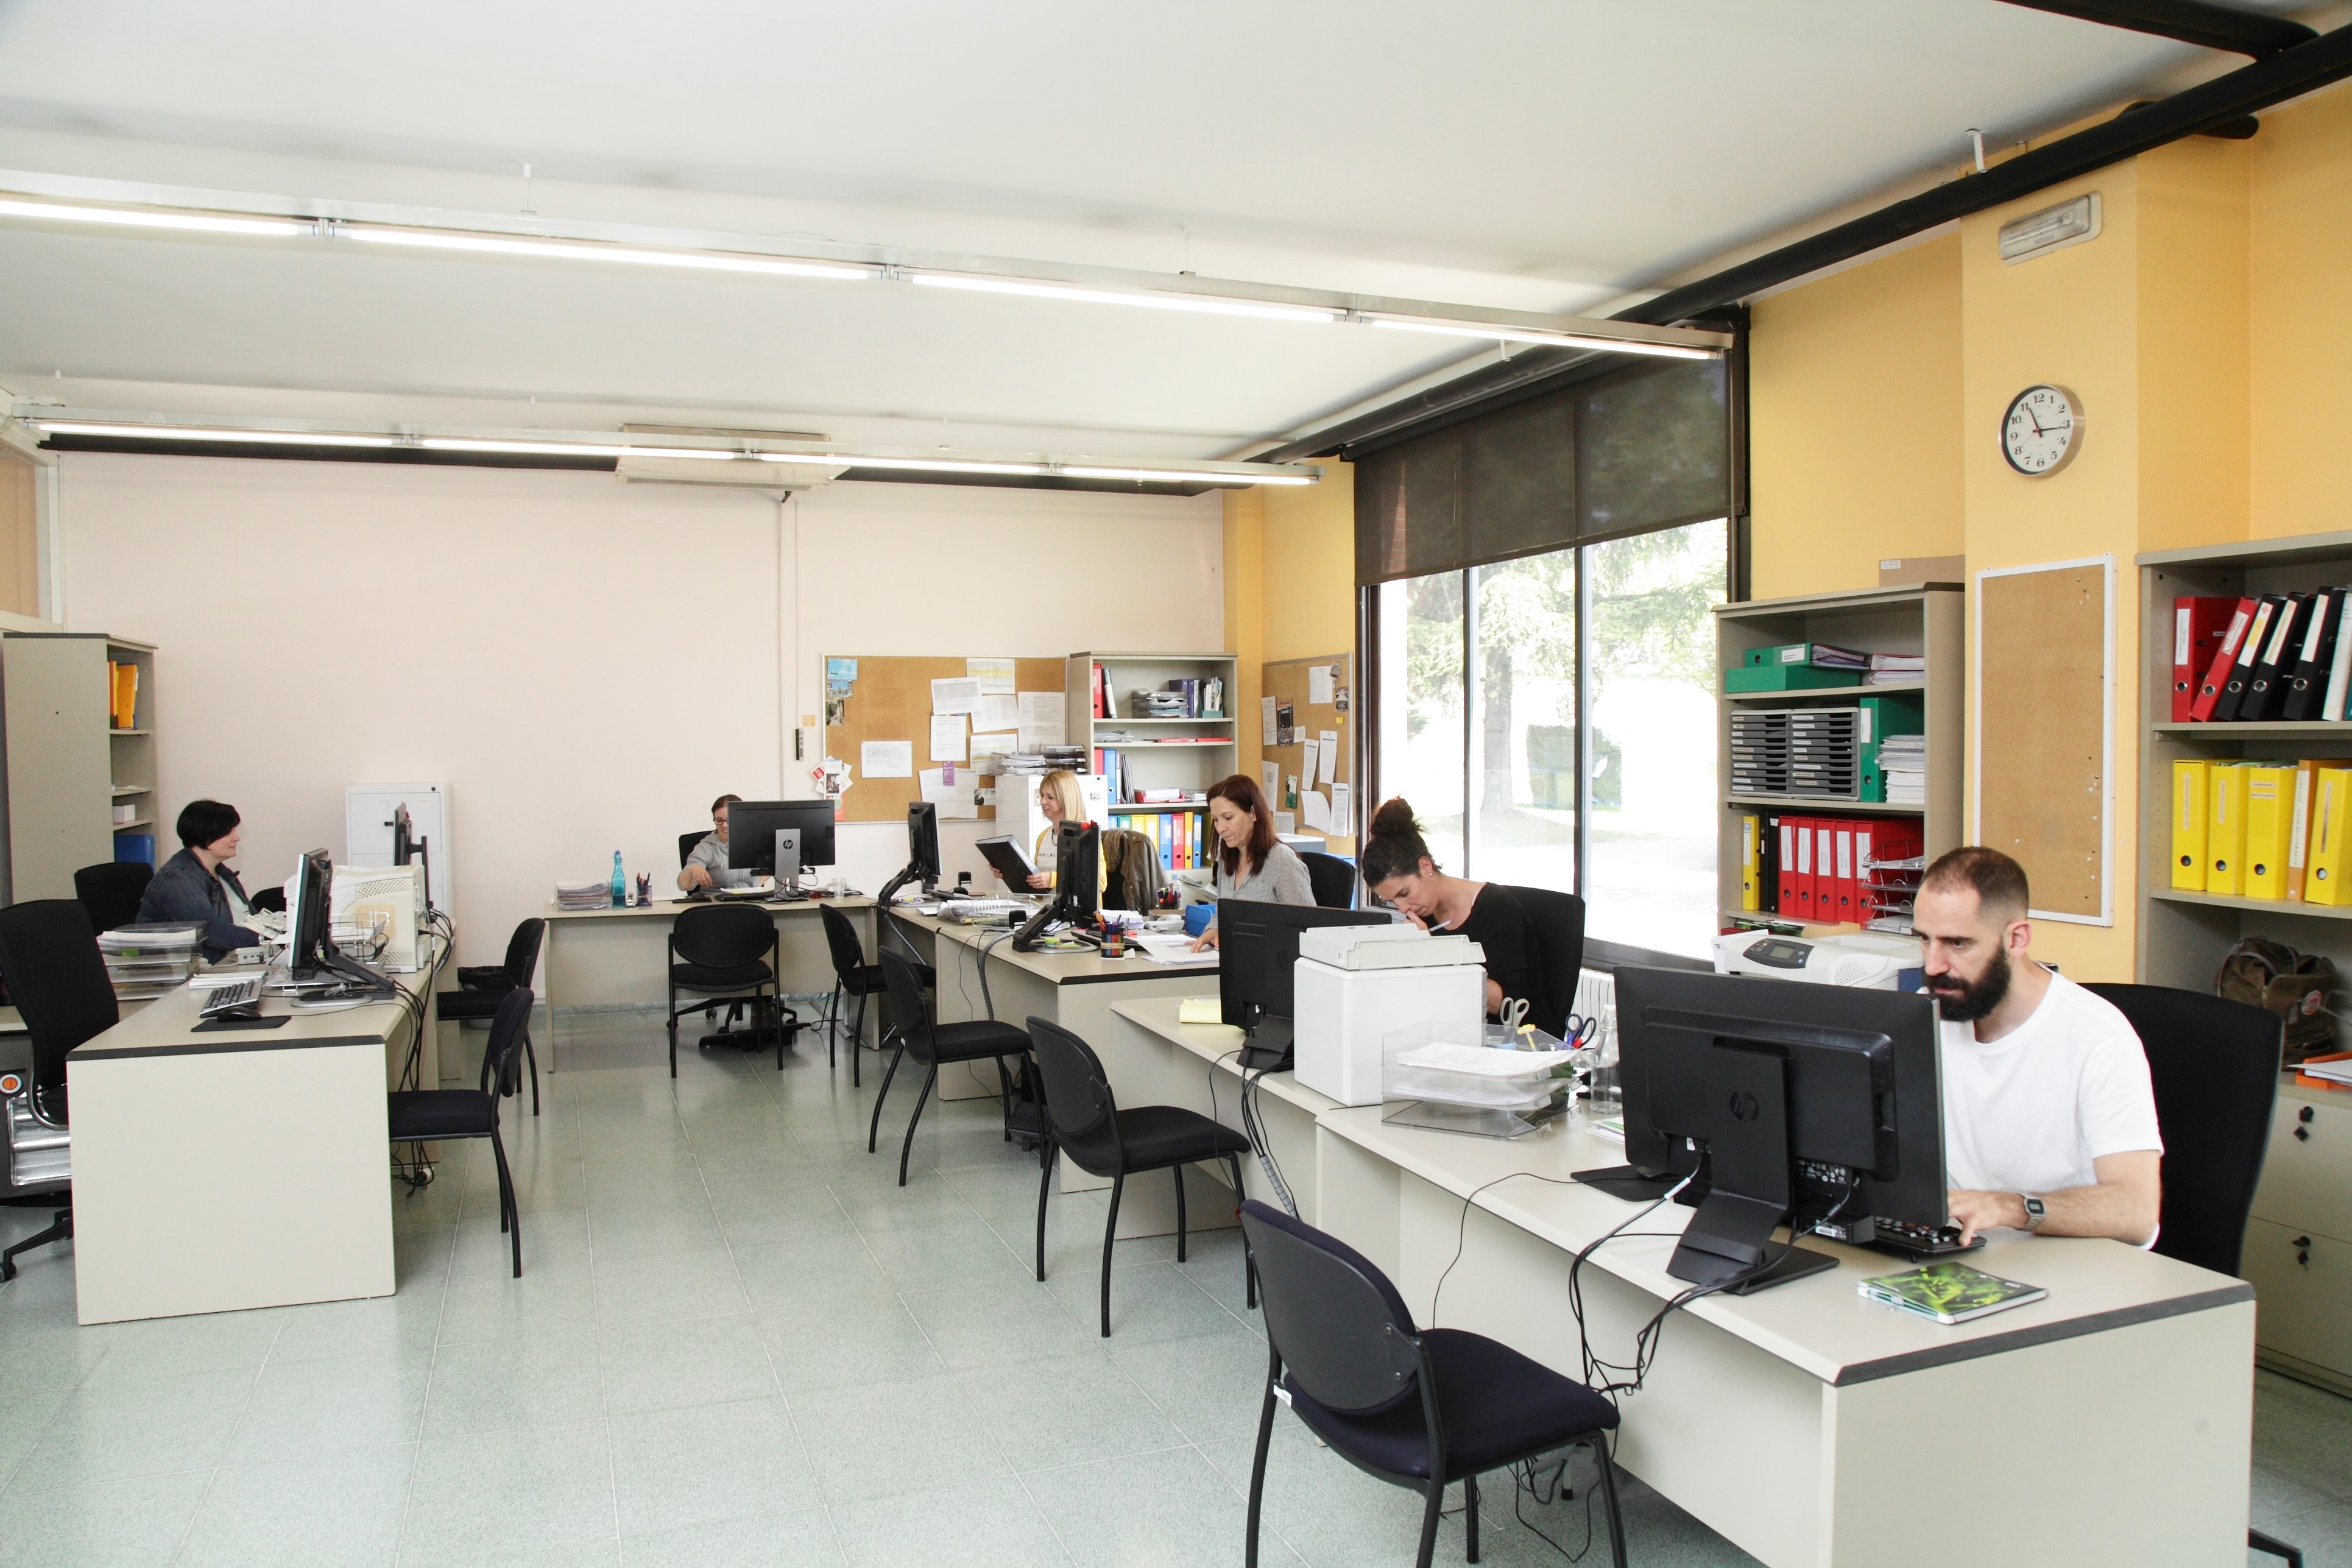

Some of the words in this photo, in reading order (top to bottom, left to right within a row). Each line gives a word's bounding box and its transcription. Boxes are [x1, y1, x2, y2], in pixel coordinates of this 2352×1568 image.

[2033, 394, 2044, 403] 12
[2021, 403, 2029, 411] 11
[2058, 404, 2065, 413] 2
[2011, 415, 2021, 425] 10
[2063, 420, 2070, 429] 3
[2010, 432, 2018, 441] 9
[2059, 437, 2067, 445] 4
[2015, 446, 2022, 455] 8
[2050, 451, 2057, 460] 5
[2024, 456, 2031, 465] 7
[2036, 458, 2044, 467] 6
[783, 839, 793, 850] hp
[1276, 950, 1290, 971] hp
[1729, 1090, 1759, 1123] hp
